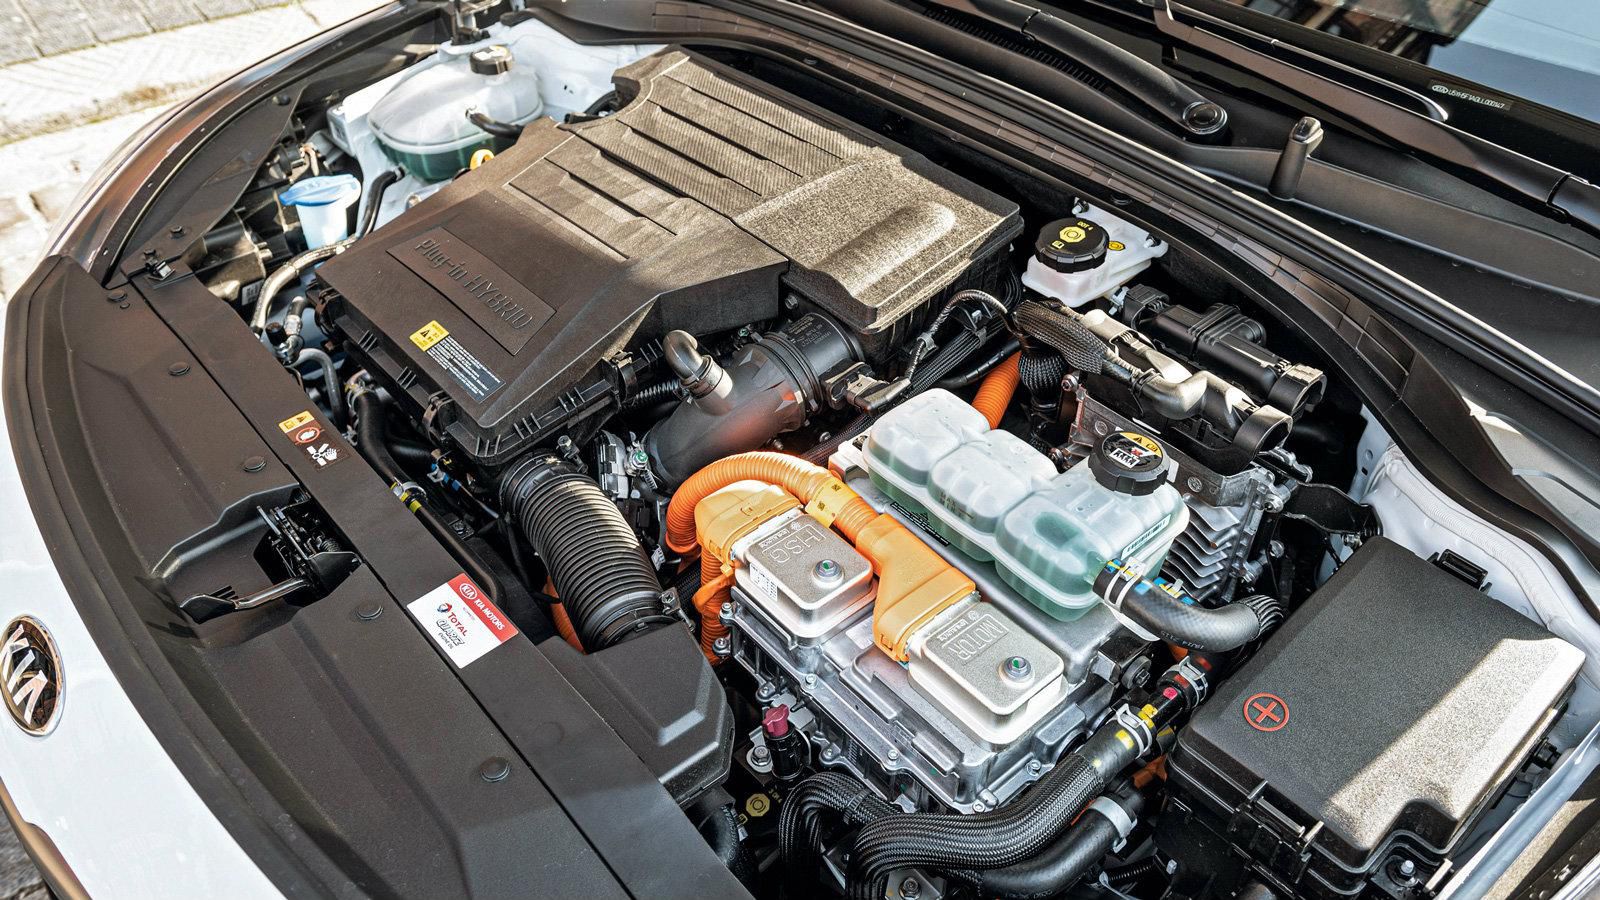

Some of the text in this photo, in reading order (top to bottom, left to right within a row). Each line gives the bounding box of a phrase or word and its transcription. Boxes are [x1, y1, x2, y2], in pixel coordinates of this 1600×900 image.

[415, 239, 533, 330] Plug-in HYBRID
[770, 527, 821, 563] HSG
[447, 612, 468, 637] TOTAL
[461, 585, 475, 598] KIA
[474, 599, 485, 611] KIA
[482, 607, 505, 631] MOTORS
[436, 619, 465, 646] QUARTZ
[948, 619, 1004, 660] MOTOR
